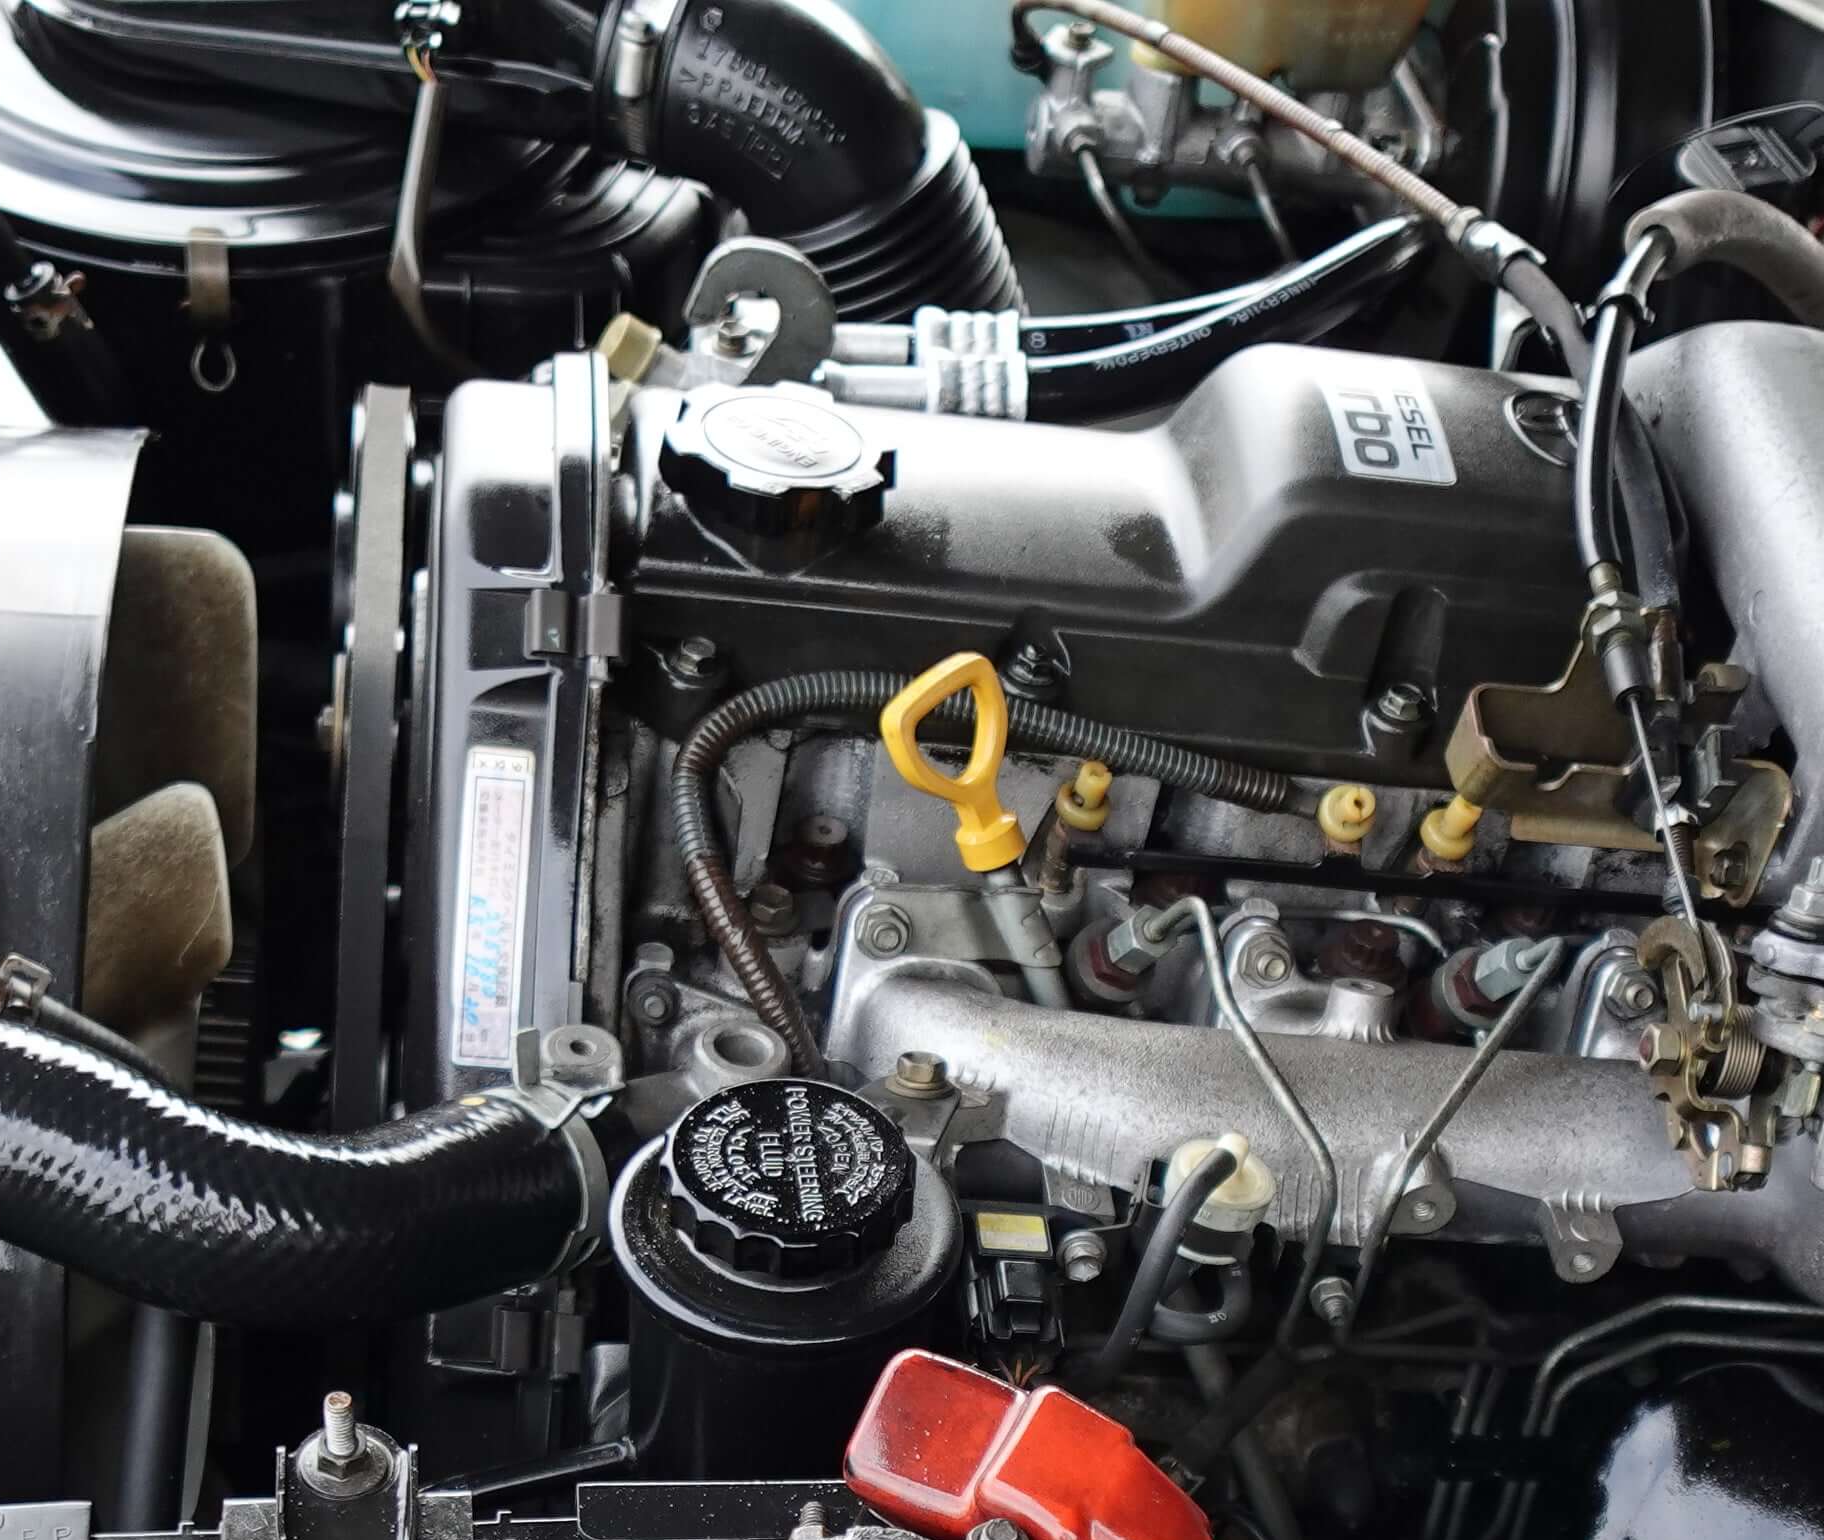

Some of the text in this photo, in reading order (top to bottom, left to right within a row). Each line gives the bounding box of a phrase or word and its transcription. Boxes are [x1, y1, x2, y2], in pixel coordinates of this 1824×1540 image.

[1338, 389, 1400, 470] rbo
[1393, 393, 1435, 461] ESEL
[759, 1133, 785, 1177] FLUID
[784, 1086, 825, 1222] POWER STEERING
